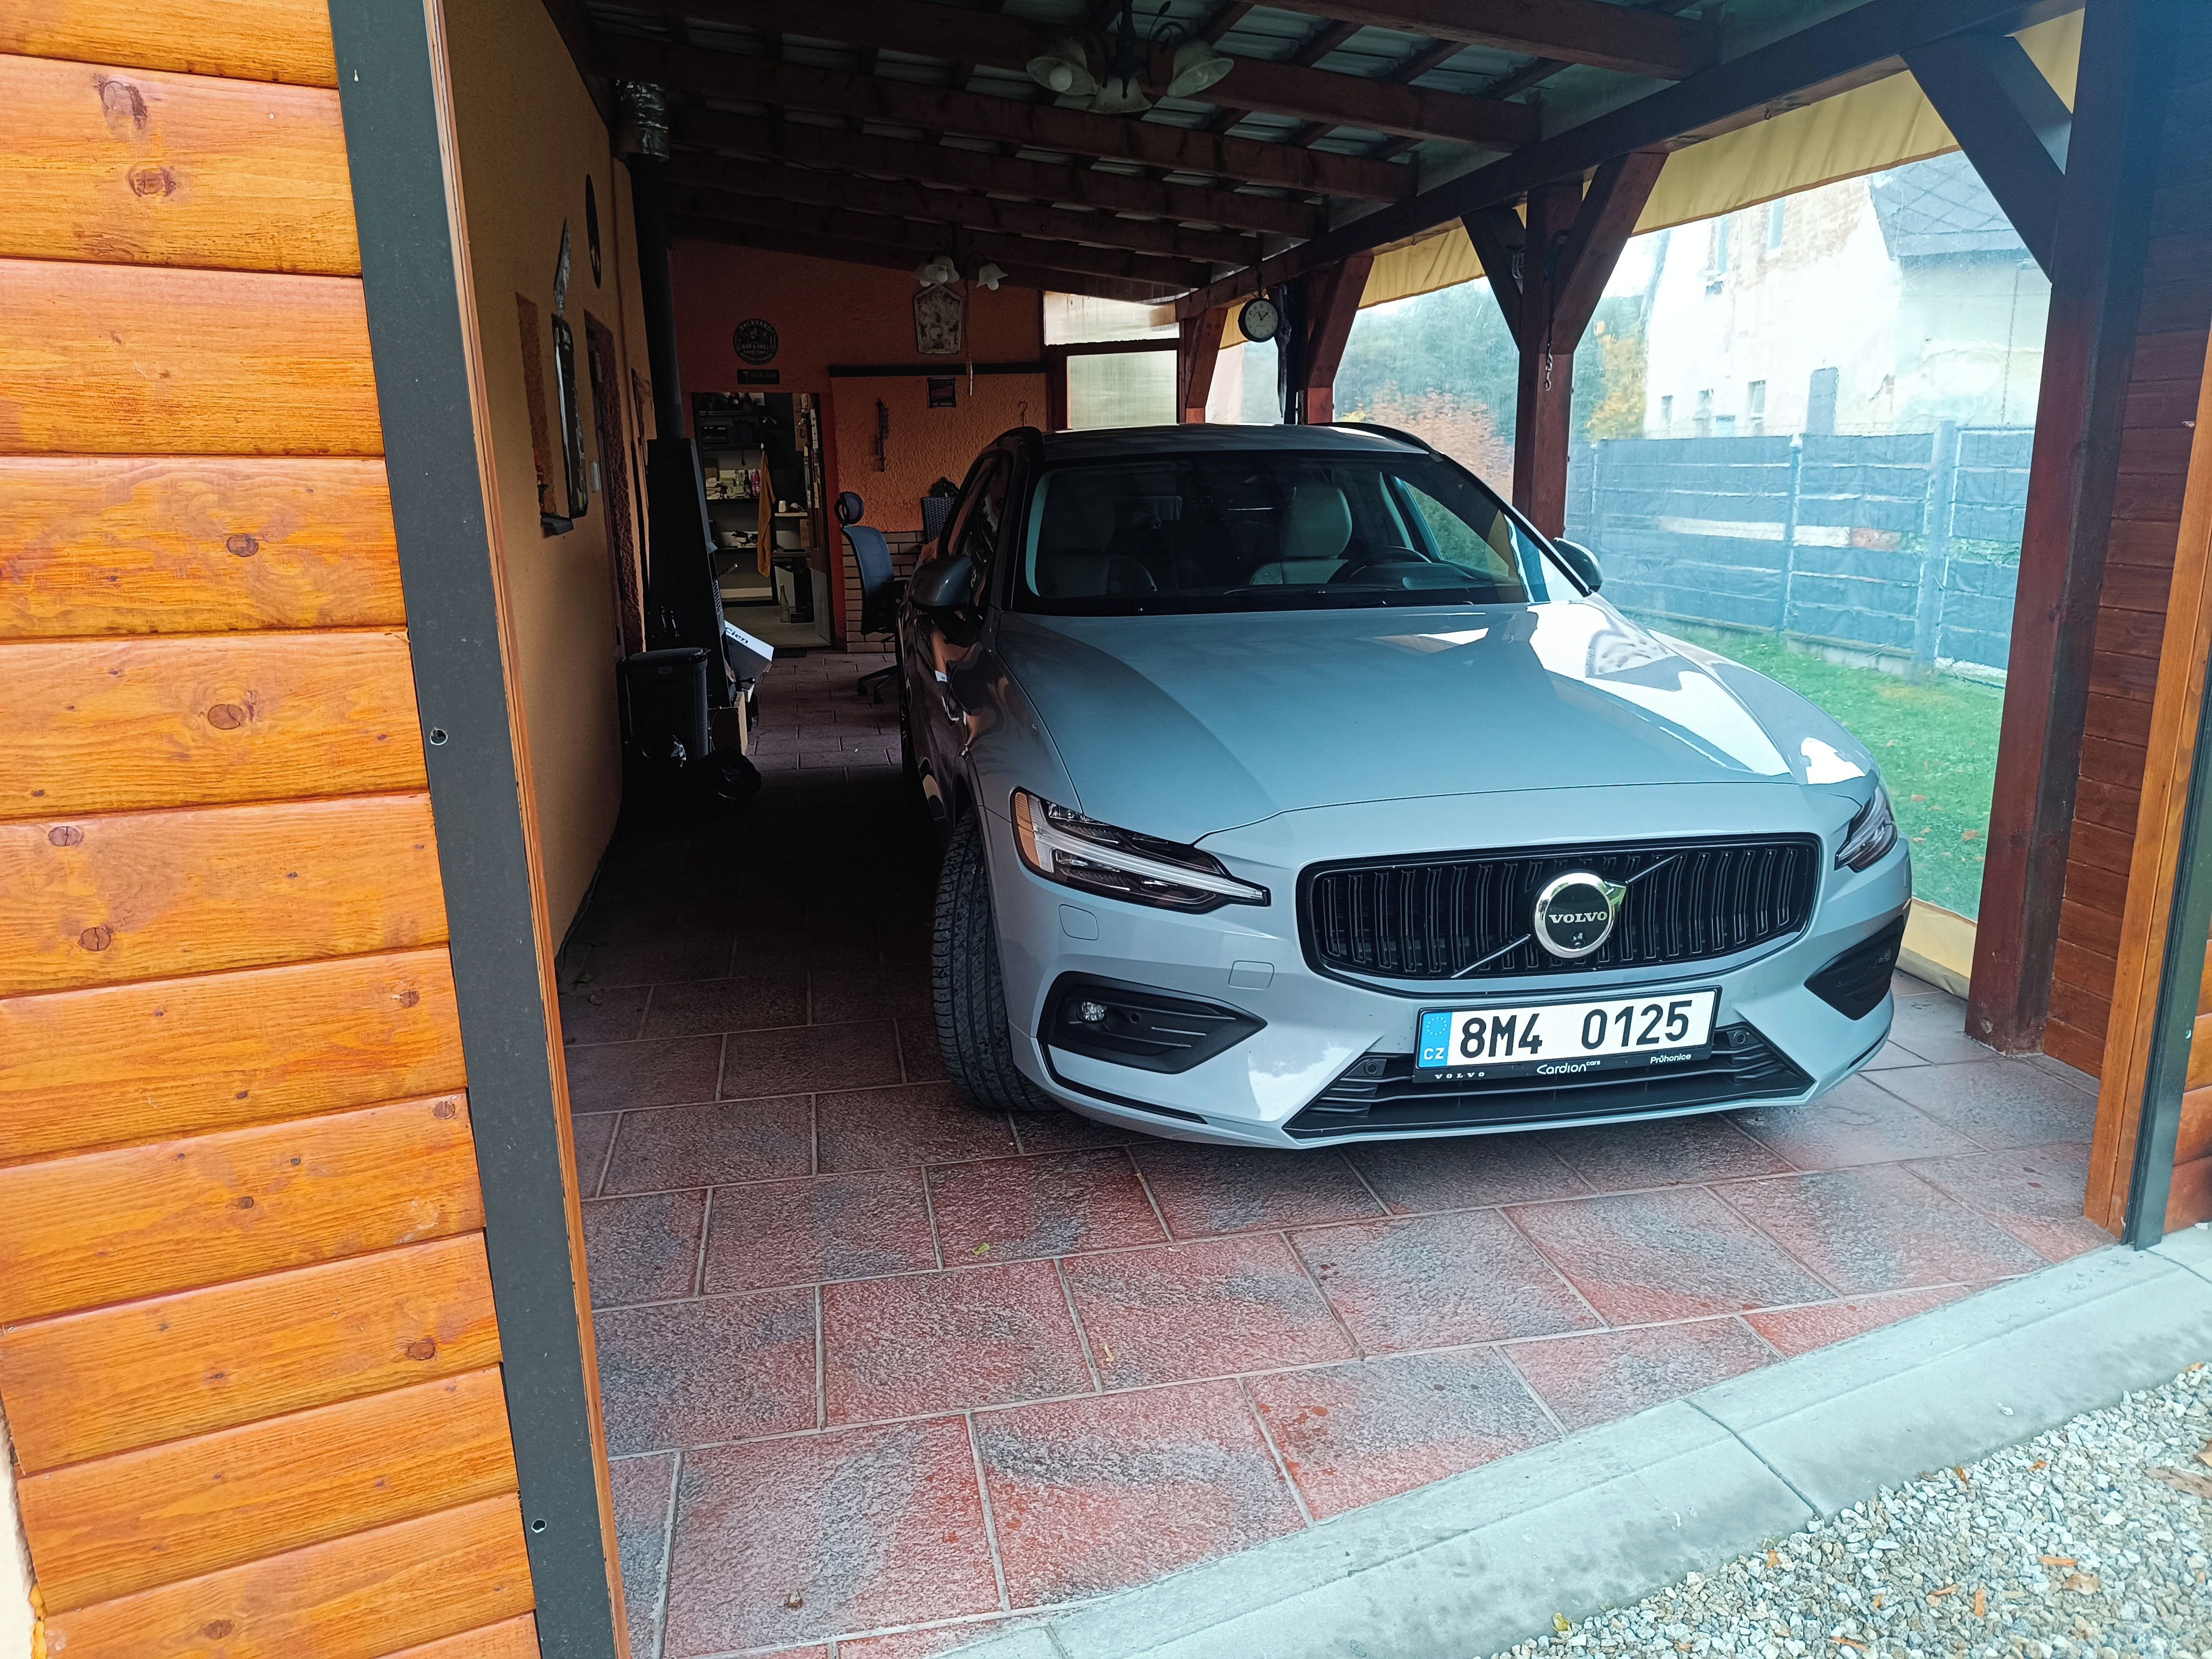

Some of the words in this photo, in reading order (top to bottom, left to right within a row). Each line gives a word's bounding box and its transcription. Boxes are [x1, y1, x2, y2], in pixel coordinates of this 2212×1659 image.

[1548, 911, 1608, 923] VOLVO
[1460, 1013, 1543, 1058] 8M4
[1581, 1000, 1693, 1050] 0125
[1424, 1047, 1445, 1060] CZ
